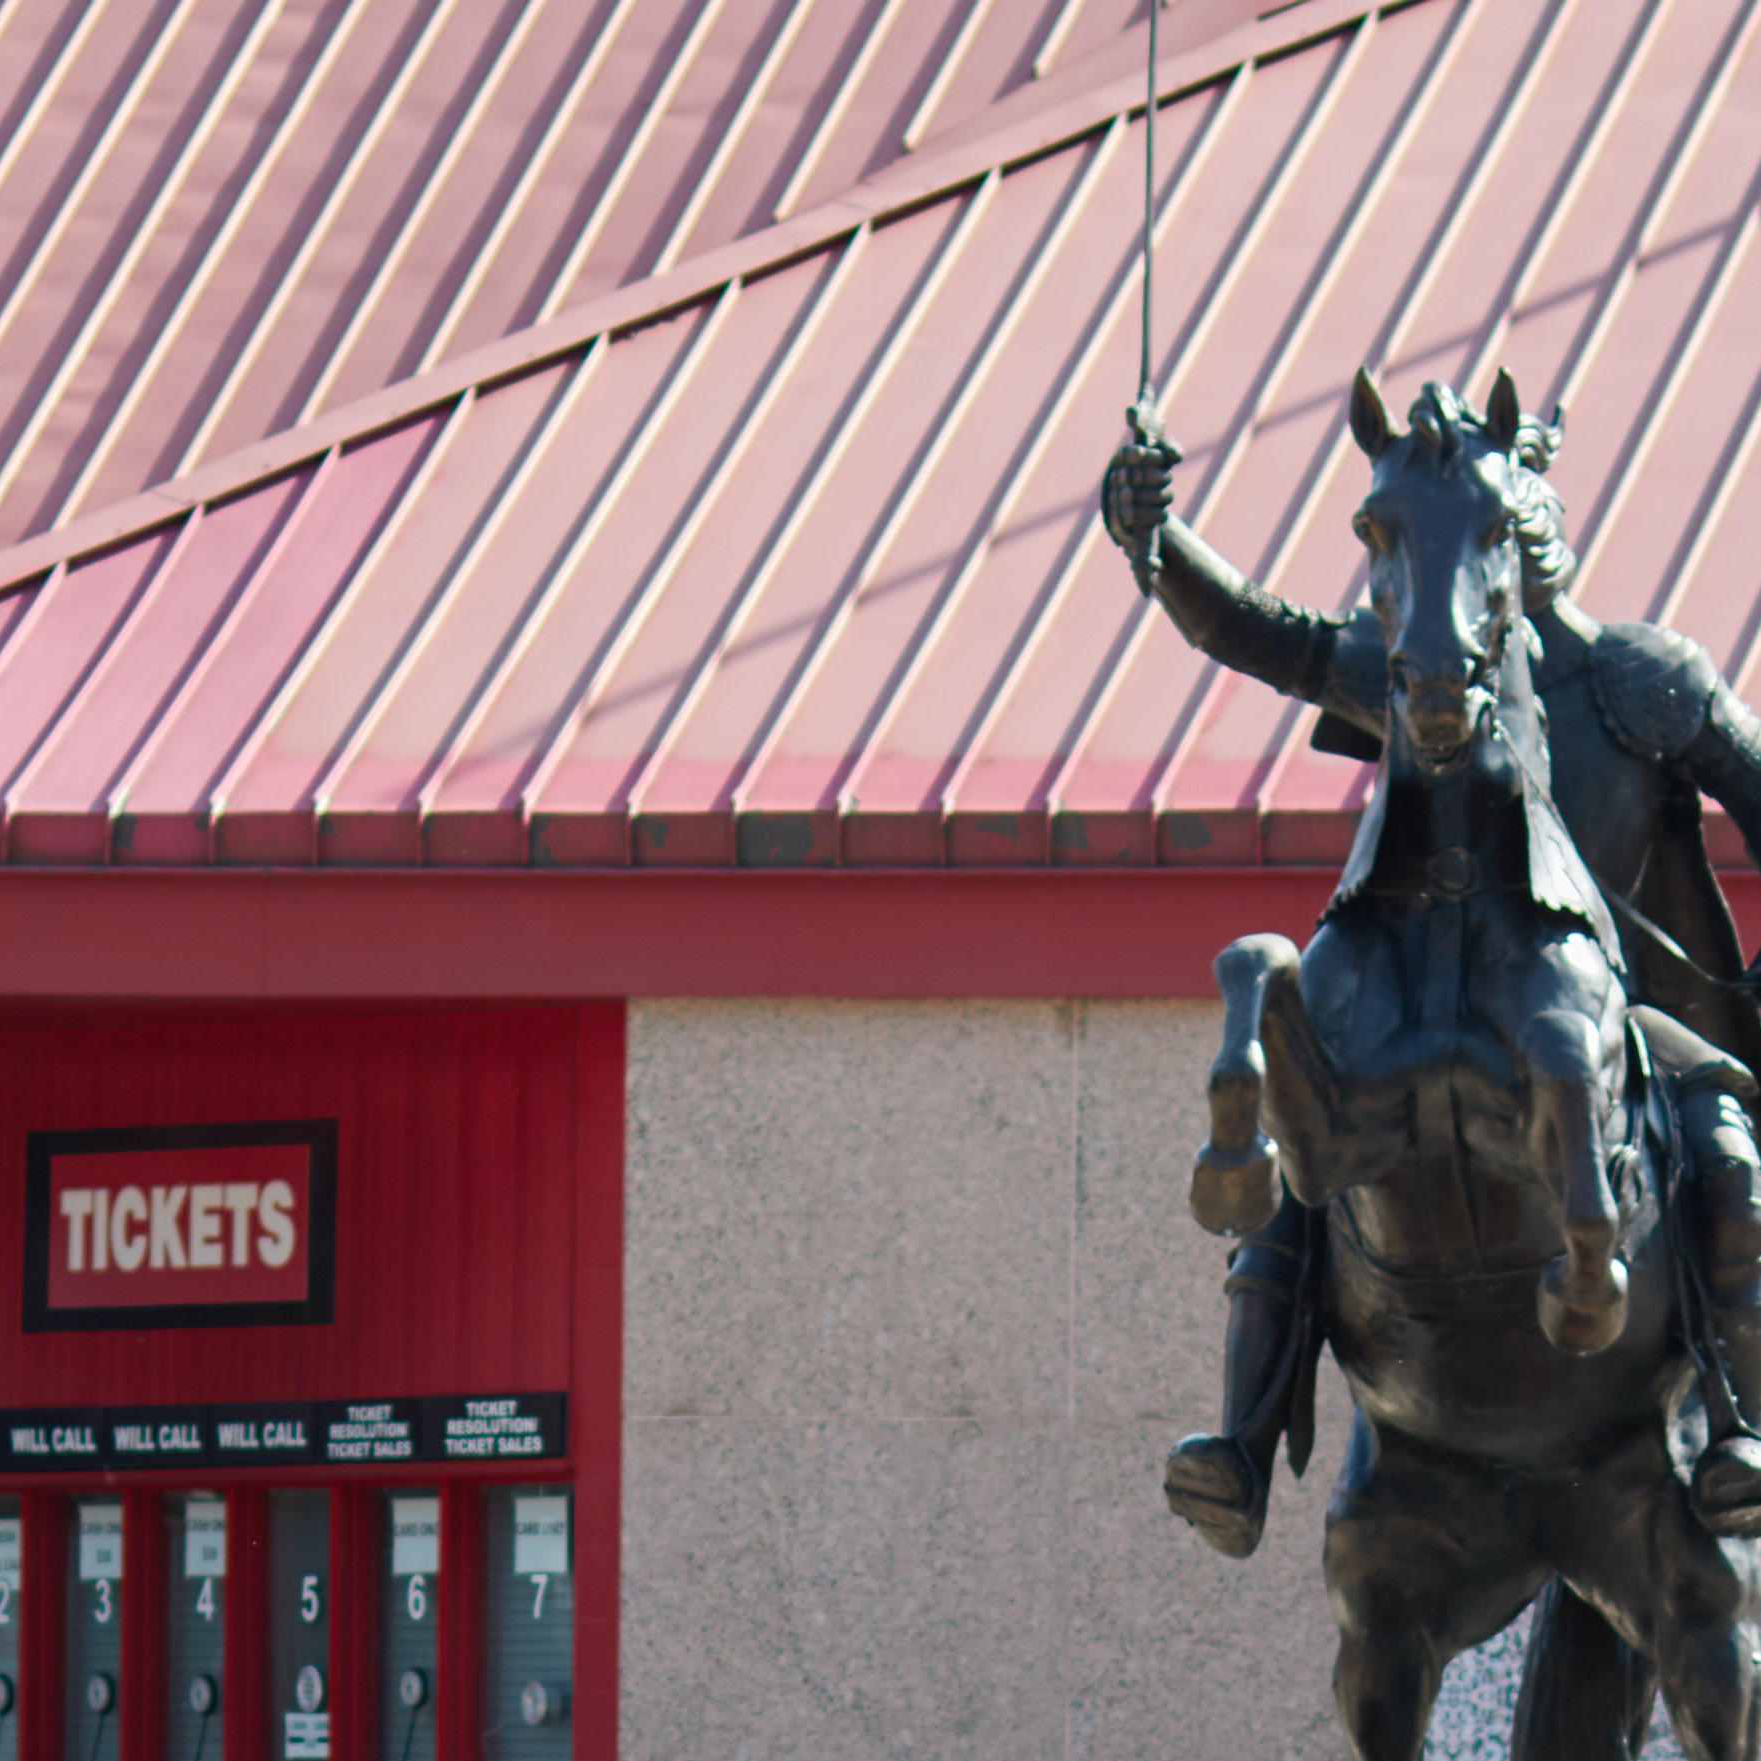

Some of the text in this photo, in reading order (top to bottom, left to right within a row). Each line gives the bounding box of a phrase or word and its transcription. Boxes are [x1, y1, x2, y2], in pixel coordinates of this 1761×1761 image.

[60, 1179, 296, 1273] TICKETS
[347, 1405, 393, 1422] TICKET
[465, 1400, 518, 1418] TICKET
[11, 1427, 97, 1453] WILL CALL
[114, 1424, 202, 1451] WILL CALL
[218, 1421, 307, 1448] WILL CALL
[444, 1435, 543, 1455] TICKET SALES
[327, 1440, 412, 1458] TICKET SALES
[94, 1578, 113, 1624] 3
[196, 1577, 214, 1622] 4
[300, 1575, 320, 1622] 5
[407, 1573, 426, 1621] 6
[530, 1573, 548, 1620] 7
